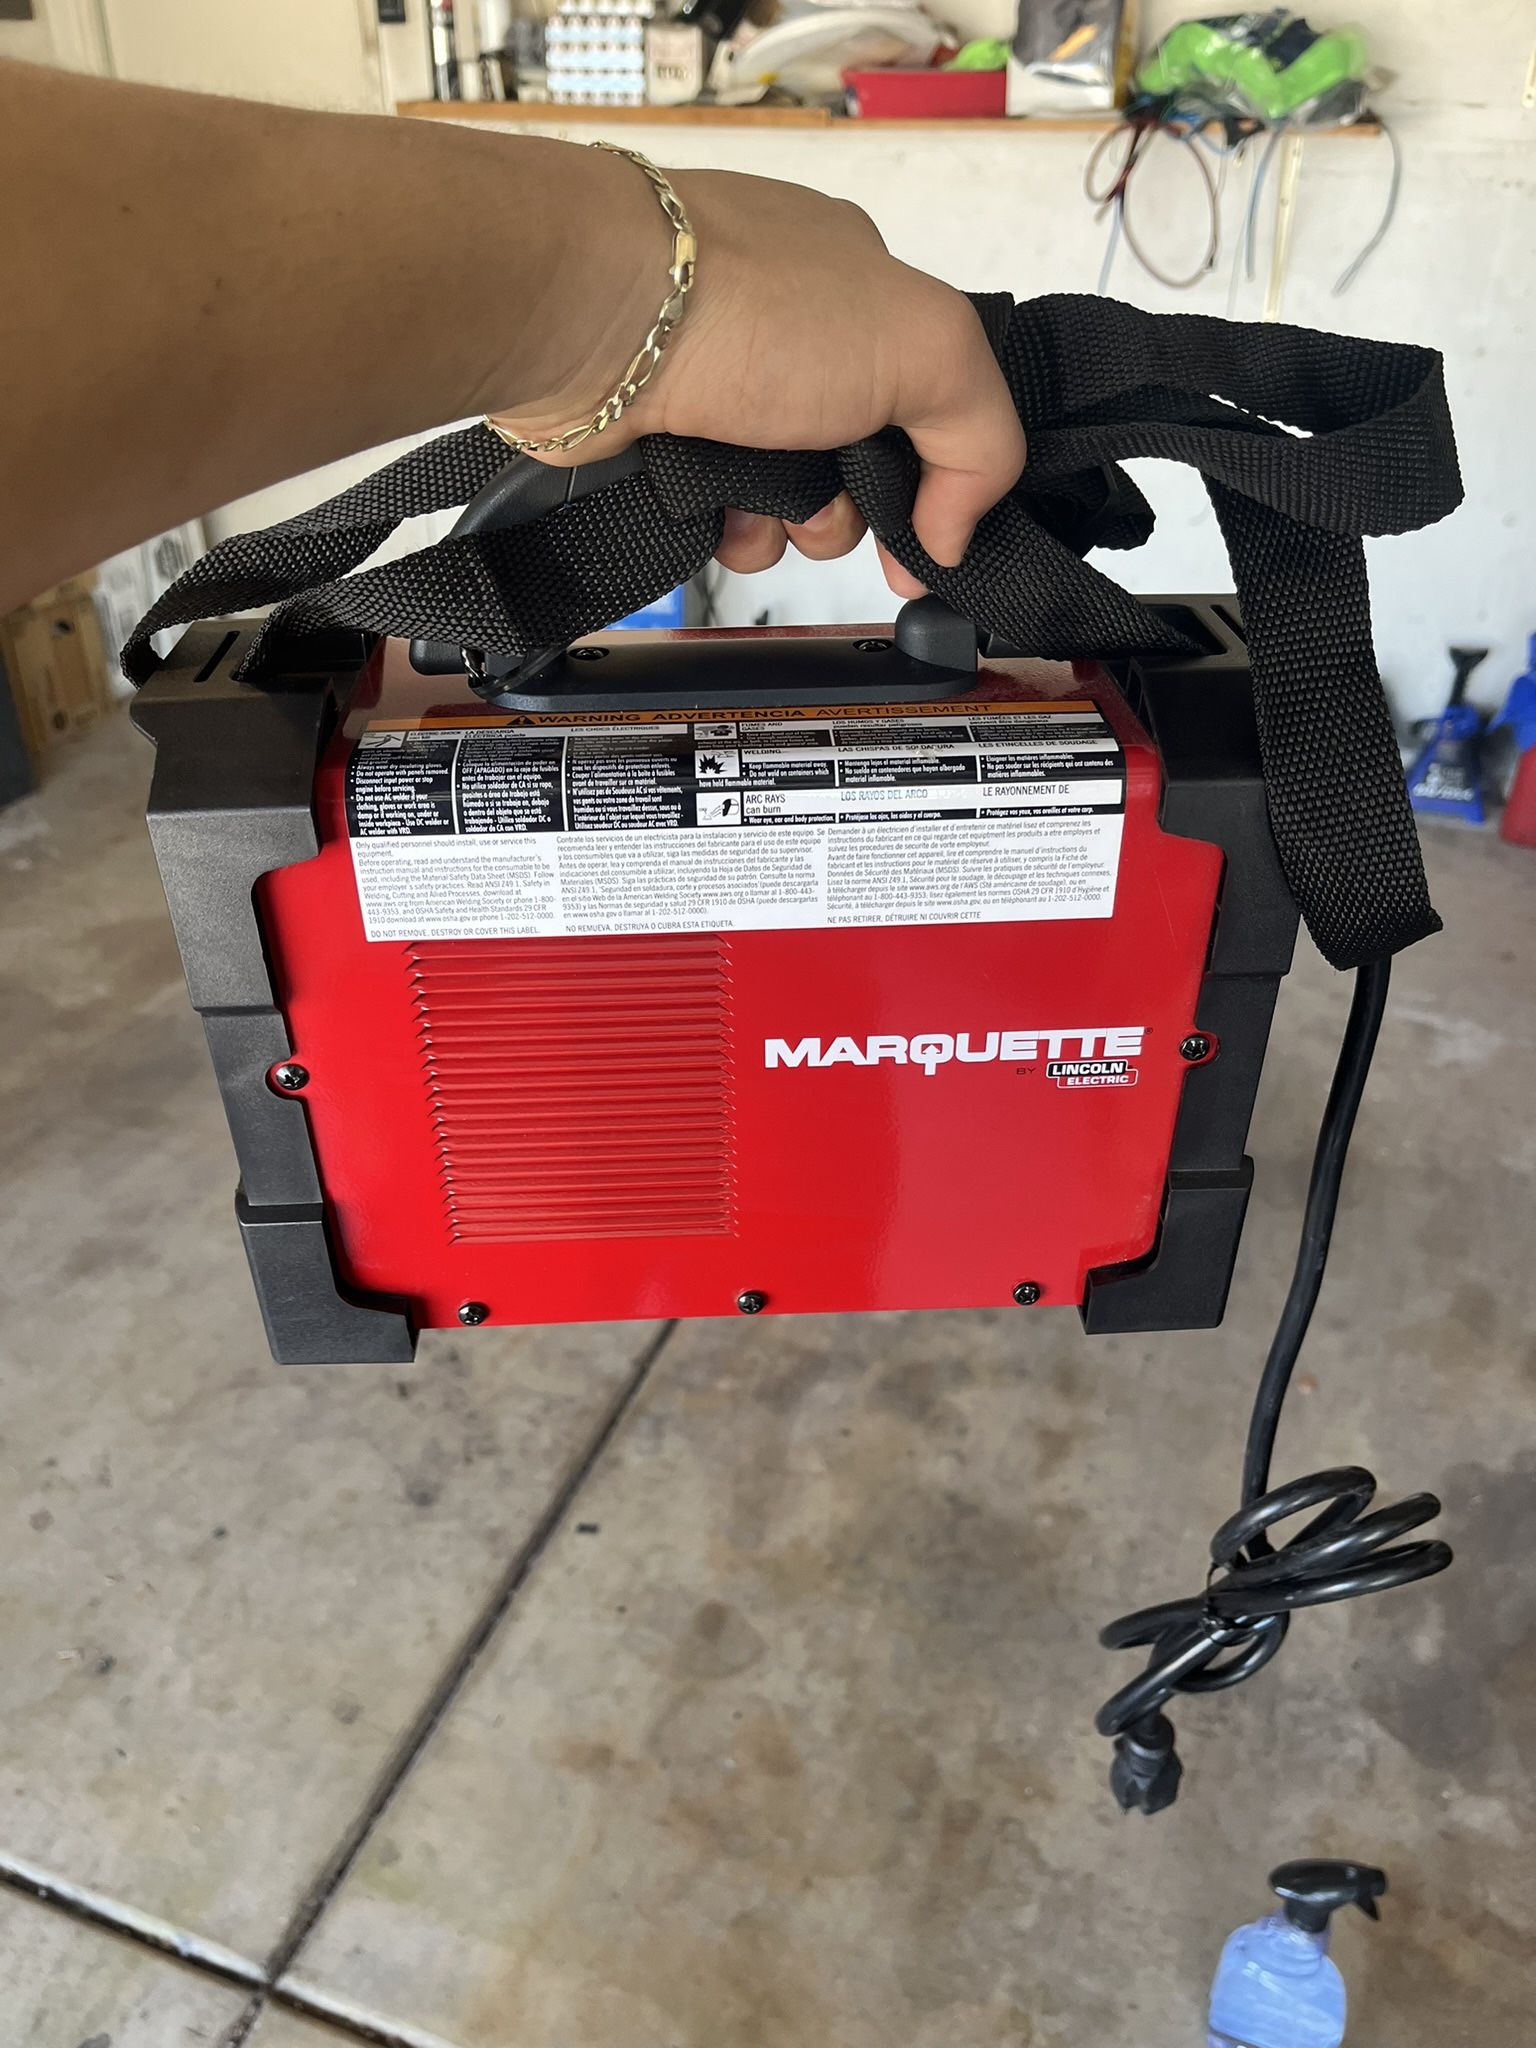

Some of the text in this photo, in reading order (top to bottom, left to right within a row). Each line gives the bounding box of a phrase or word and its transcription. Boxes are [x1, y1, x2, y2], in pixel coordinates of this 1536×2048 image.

[538, 704, 992, 723] WARNING ADVERTENCIA AVERTISSEMENT
[841, 789, 928, 801] LOS RAYOS DEL ARCO
[983, 784, 1070, 796] LE RAYONNEMENT DE
[746, 794, 786, 804] ARC RAYS
[763, 805, 781, 813] burn
[795, 815, 808, 824] body
[808, 815, 834, 823] protection.
[356, 841, 371, 850] Only
[371, 841, 399, 850] qualified
[401, 840, 432, 849] personnel
[433, 839, 455, 847] should
[456, 839, 477, 847] install,
[359, 858, 380, 866] Before
[380, 858, 412, 867] operating,
[414, 857, 429, 865] read
[443, 856, 479, 864] understand
[362, 875, 378, 884] used,
[380, 874, 409, 884] including
[421, 873, 448, 881] Material
[449, 873, 469, 882] Safety
[471, 872, 485, 880] Data
[506, 871, 532, 880] (MSDS).
[386, 915, 415, 923] download
[425, 914, 470, 924] www.osha.gov
[479, 913, 499, 923] phone
[500, 912, 555, 920] 1-202-512-0000.
[853, 914, 883, 923] RETIRER,
[885, 911, 918, 921] DÉTRUIRE
[929, 912, 959, 920] COUVRIR
[960, 911, 981, 919] CETTE
[370, 930, 381, 938] DO
[382, 929, 397, 937] NOT
[398, 929, 428, 937] REMOVE,
[431, 928, 463, 936] DESTROY
[475, 927, 498, 935] COVER
[517, 926, 540, 934] LABEL.
[578, 924, 612, 932] REMUEVA,
[614, 922, 648, 930] DESTRUYA
[658, 921, 681, 929] CUBRA
[764, 1026, 1145, 1075] MARQUETTE
[1016, 1067, 1036, 1075] BY
[1052, 1062, 1125, 1076] LINCOLN
[1066, 1075, 1130, 1086] ELECTRIC
